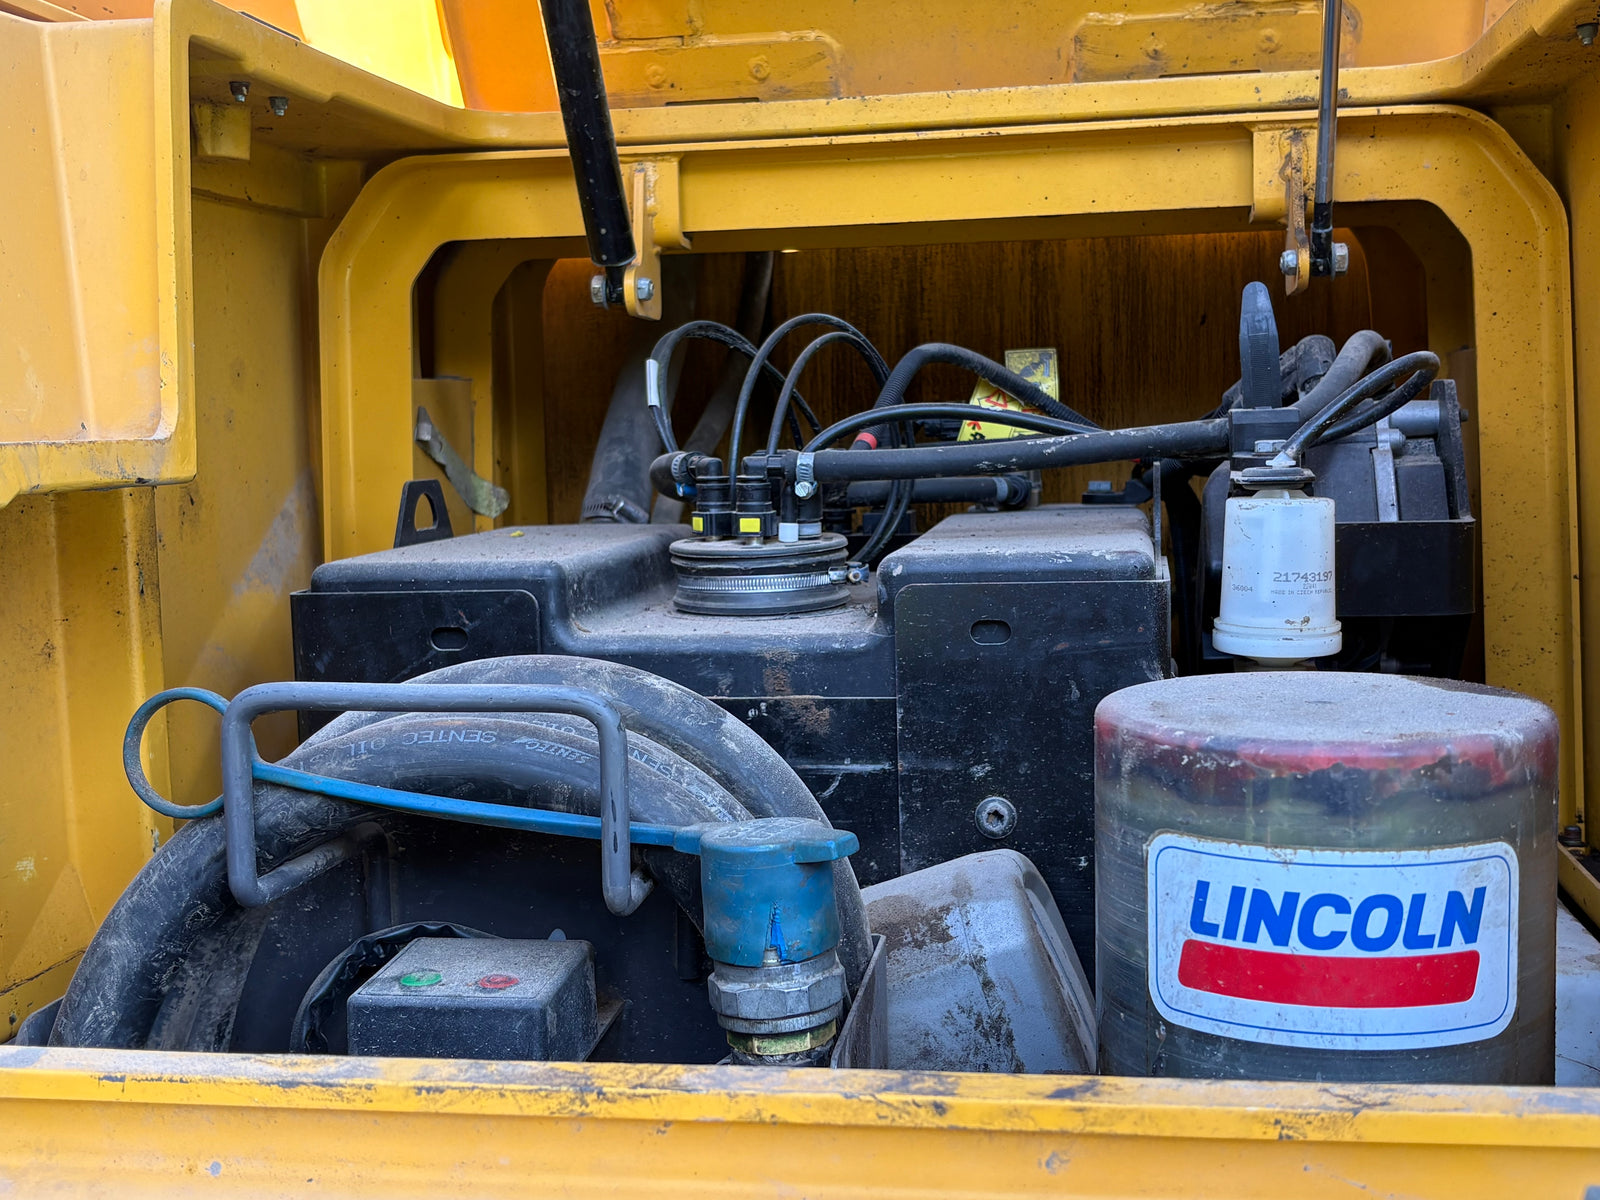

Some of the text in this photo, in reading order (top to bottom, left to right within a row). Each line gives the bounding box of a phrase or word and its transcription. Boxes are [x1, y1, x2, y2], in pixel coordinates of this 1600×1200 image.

[1272, 571, 1333, 583] 21743197
[402, 729, 498, 745] SENTEC
[525, 740, 591, 765] SENTEC
[1189, 879, 1487, 952] LINCOLN
